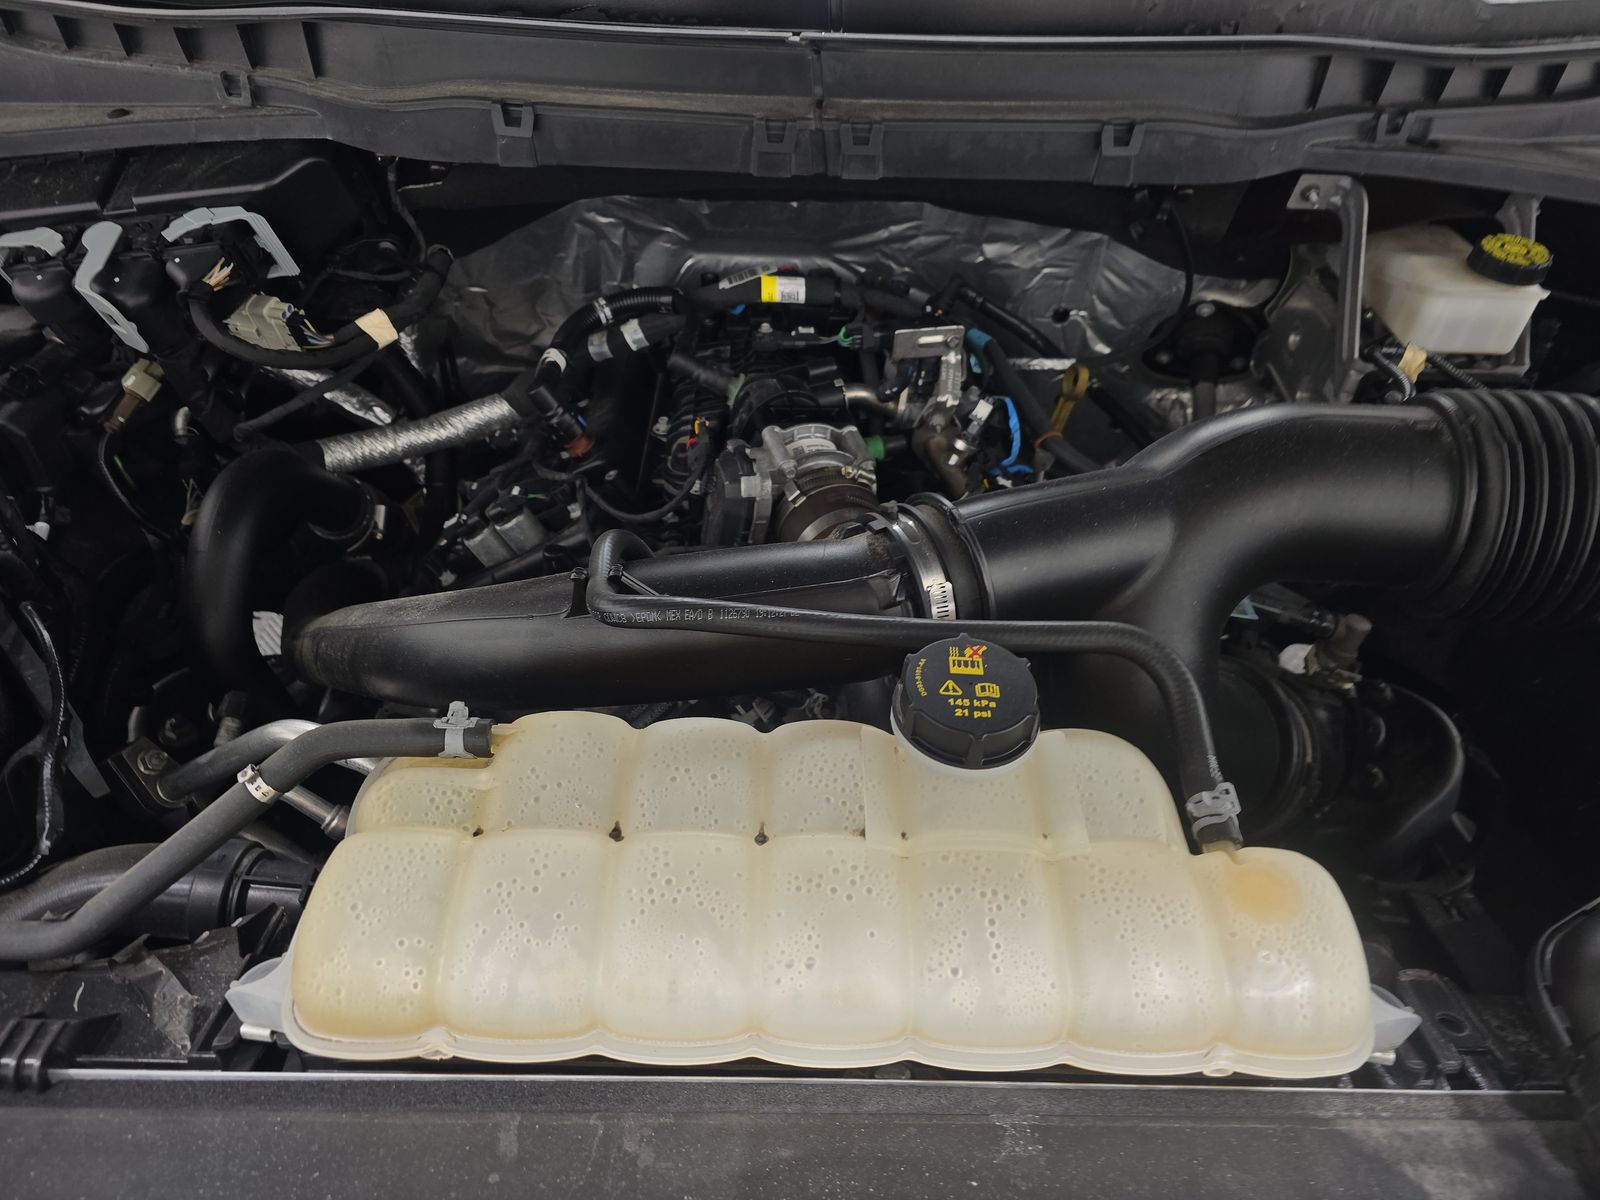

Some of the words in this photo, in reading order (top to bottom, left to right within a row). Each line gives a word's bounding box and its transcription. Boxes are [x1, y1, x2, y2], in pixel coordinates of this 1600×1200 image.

[947, 698, 970, 707] 145
[973, 698, 997, 708] kPa
[954, 708, 969, 717] 21
